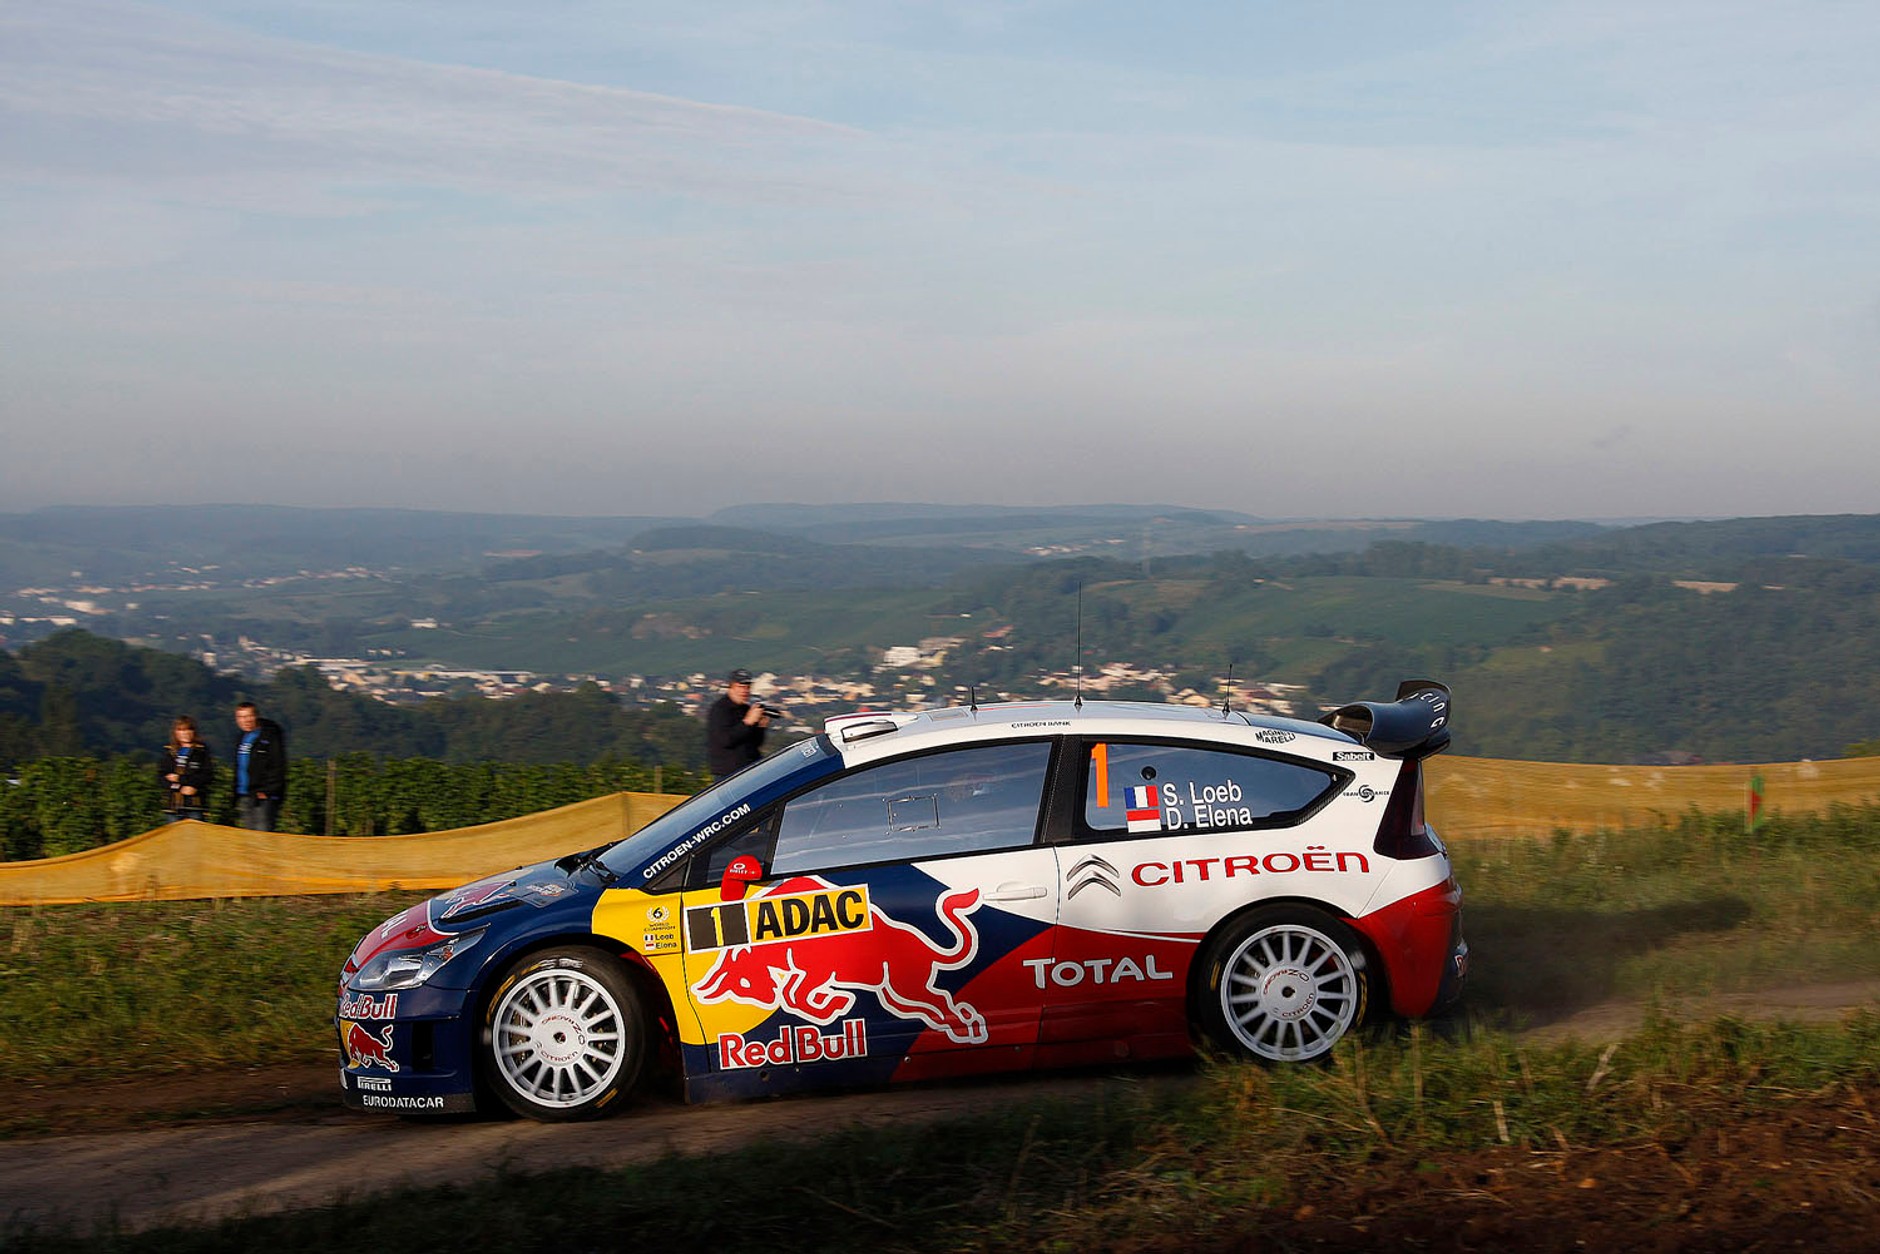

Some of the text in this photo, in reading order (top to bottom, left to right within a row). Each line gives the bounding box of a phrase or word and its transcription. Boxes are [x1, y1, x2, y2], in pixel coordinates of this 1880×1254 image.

[1091, 743, 1109, 808] 1
[1162, 779, 1242, 807] S. Loeb
[1166, 804, 1253, 831] D. Elena
[643, 803, 751, 879] CITROEN-WRC.COM
[711, 891, 864, 947] 1 ADAC
[1022, 954, 1174, 990] TOTAL
[361, 993, 398, 1019] Bull
[718, 1018, 868, 1070] Red Bull
[357, 1076, 392, 1092] PIRELLI
[362, 1094, 444, 1109] EURODATACAR
